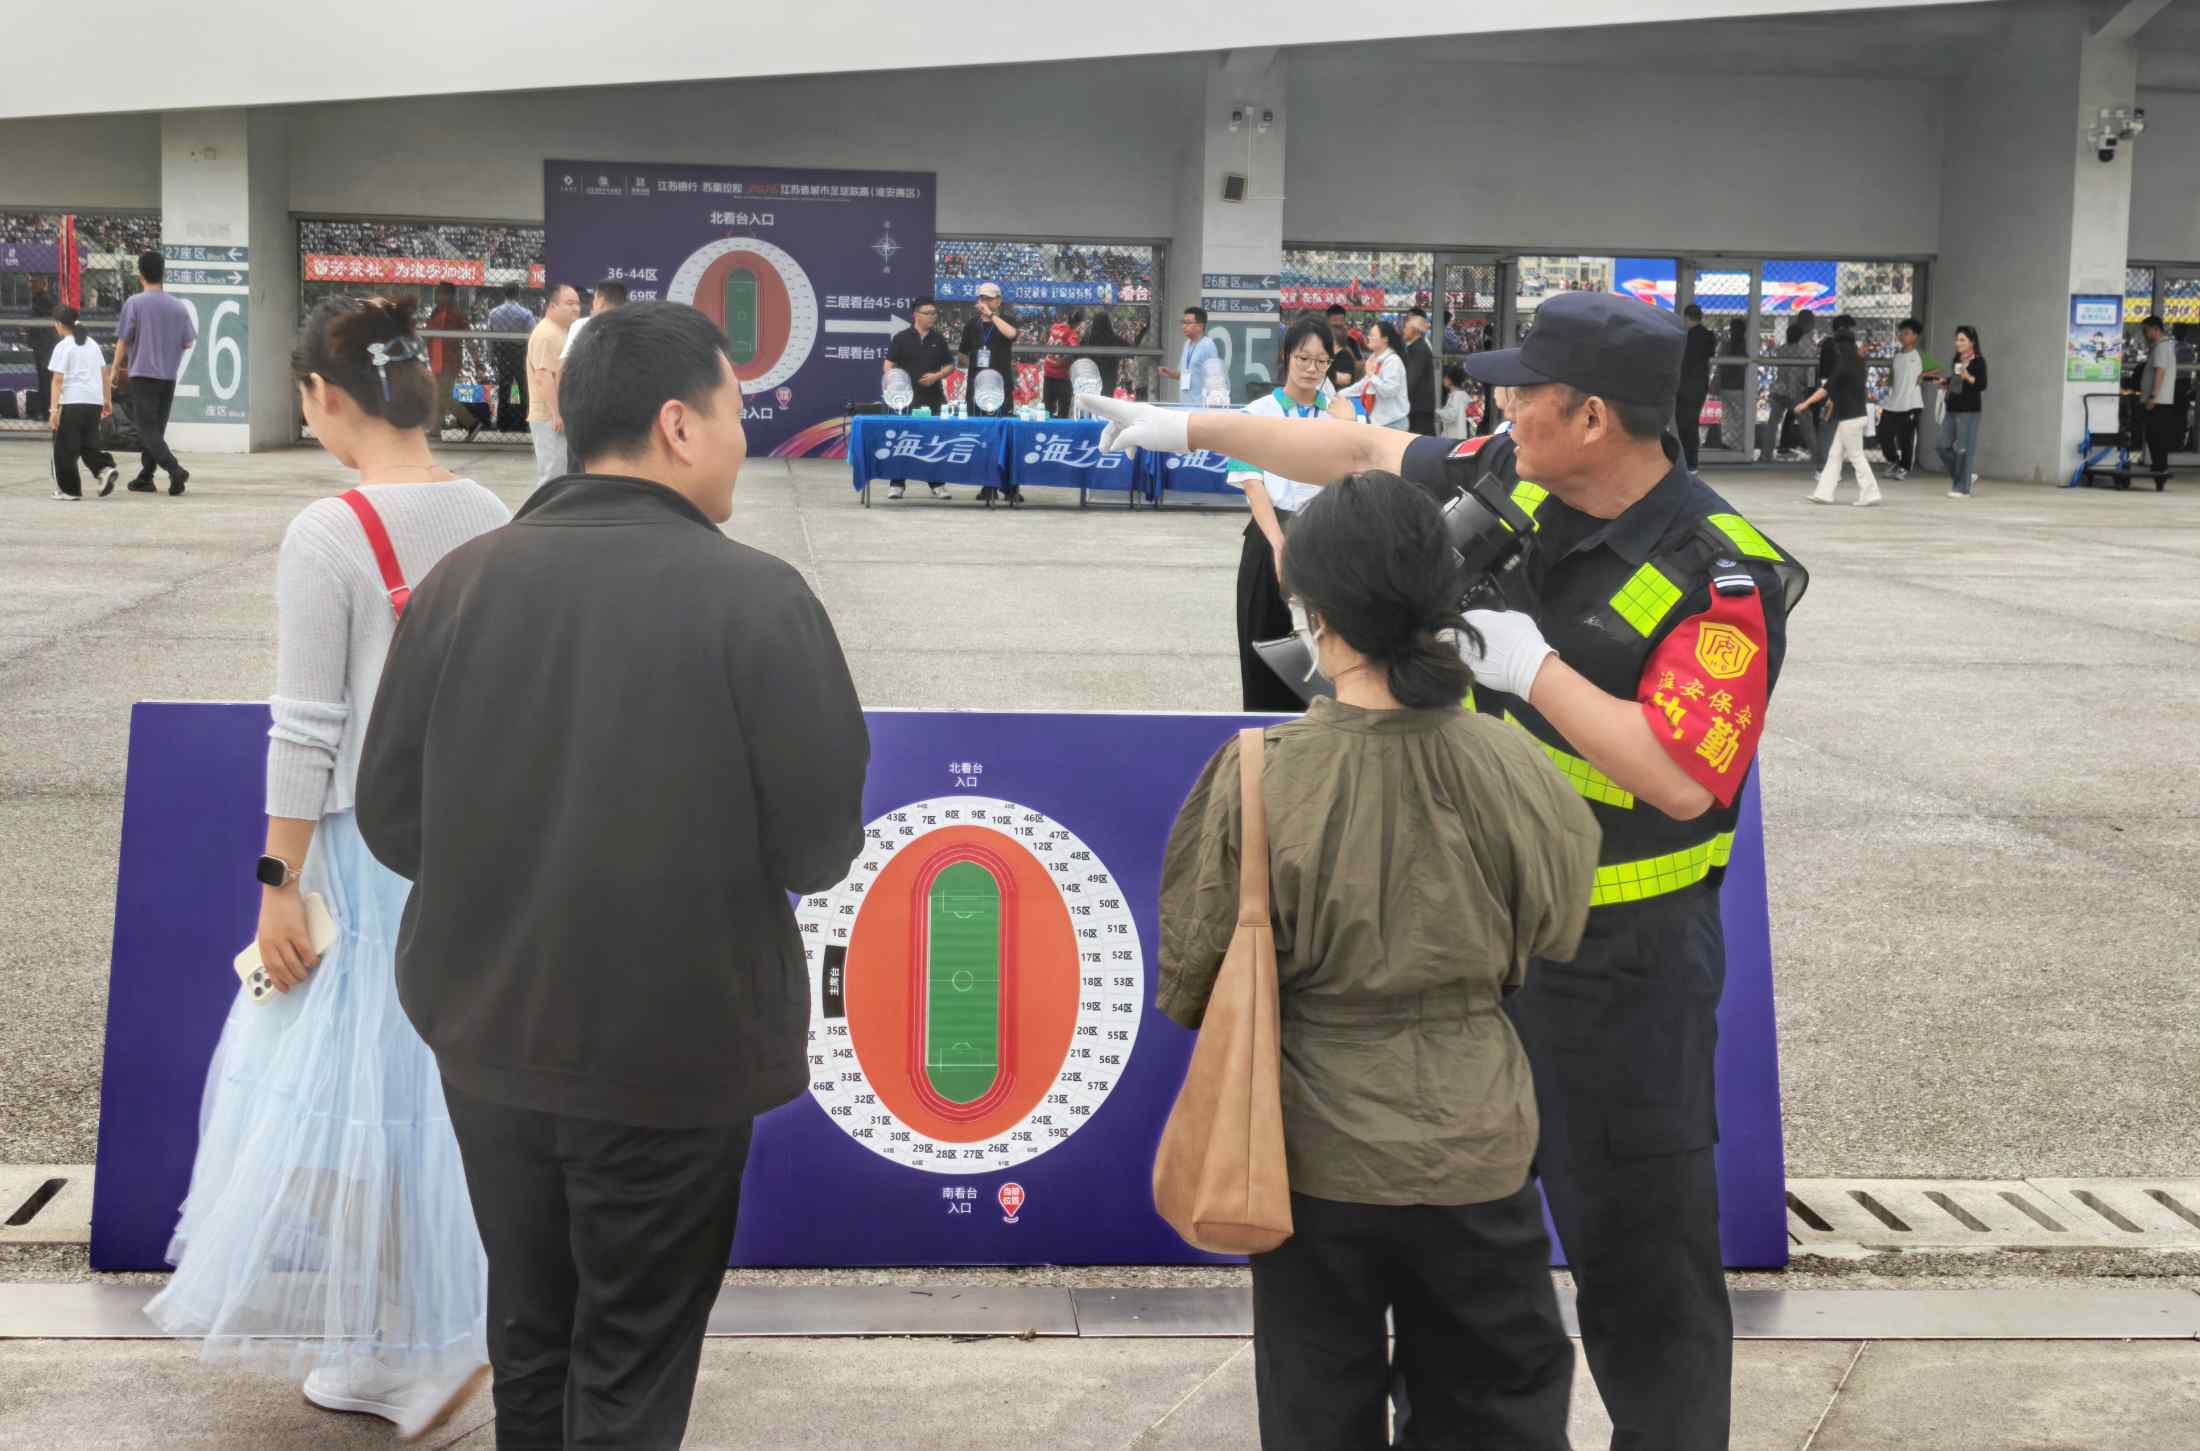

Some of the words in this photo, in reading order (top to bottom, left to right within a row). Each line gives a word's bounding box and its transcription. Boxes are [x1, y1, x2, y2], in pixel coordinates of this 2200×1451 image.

[710, 211, 775, 227] 北看台入口
[166, 247, 206, 259] 27座区
[165, 271, 206, 283] 25座区
[608, 267, 658, 281] 36-44区
[1203, 276, 1241, 288] 26座区
[824, 295, 914, 310] 三层看台45-61
[1203, 299, 1241, 312] 24座区
[875, 429, 982, 463] 海之言
[1656, 671, 1753, 731] 淮安保安
[948, 762, 983, 774] 北看台
[954, 776, 977, 788] 入口
[886, 812, 907, 822] 43区
[945, 810, 960, 819] 8区
[971, 810, 986, 819] 9区
[1023, 813, 1044, 823] 46区
[922, 815, 937, 825] 7区
[992, 816, 1012, 825] 10区
[866, 829, 880, 838] 2区
[899, 826, 914, 836] 6区
[1014, 827, 1034, 836] 11区
[1049, 831, 1070, 840] 47区
[880, 840, 895, 849] 5区
[1033, 842, 1053, 851] 12区
[1070, 851, 1090, 861] 48区
[864, 861, 878, 871] 4区
[1049, 862, 1069, 871] 13区
[1087, 874, 1108, 883] 49区
[850, 883, 864, 893] 3区
[1061, 883, 1081, 893] 14区
[808, 898, 828, 908] 39区
[1099, 899, 1120, 909] 50区
[840, 905, 855, 914] 2区
[1071, 906, 1090, 915] 15区
[833, 928, 848, 937] 1区
[1078, 928, 1098, 938] 16区
[1107, 924, 1128, 934] 51区
[1081, 952, 1102, 962] 17区
[1112, 950, 1133, 960] 52区
[829, 967, 840, 996] 主席台
[1082, 977, 1103, 987] 18区
[1113, 977, 1135, 987] 53区
[1081, 1001, 1101, 1011] 19区
[1112, 1003, 1133, 1013] 54区
[827, 1026, 848, 1036] 35区
[1077, 1026, 1097, 1036] 20区
[1107, 1030, 1128, 1040] 55区
[833, 1048, 854, 1058] 34区
[1070, 1048, 1091, 1058] 21区
[809, 1055, 824, 1065] 7区
[1099, 1055, 1121, 1065] 56区
[841, 1072, 862, 1082] 33区
[1061, 1072, 1082, 1081] 22区
[813, 1081, 834, 1091] 66区
[1087, 1081, 1108, 1091] 57区
[854, 1094, 875, 1104] 32区
[1047, 1094, 1068, 1104] 23区
[831, 1106, 852, 1116] 65区
[1070, 1105, 1091, 1115] 58区
[871, 1115, 891, 1125] 31区
[1031, 1115, 1052, 1125] 24区
[852, 1128, 873, 1138] 64区
[889, 1132, 910, 1142] 30区
[1011, 1131, 1032, 1141] 25区
[1048, 1128, 1069, 1138] 59区
[913, 1143, 934, 1153] 29区
[988, 1143, 1009, 1153] 26区
[936, 1149, 957, 1159] 28区
[963, 1149, 985, 1159] 27区
[942, 1187, 978, 1199] 南看台
[948, 1202, 972, 1214] 入口
